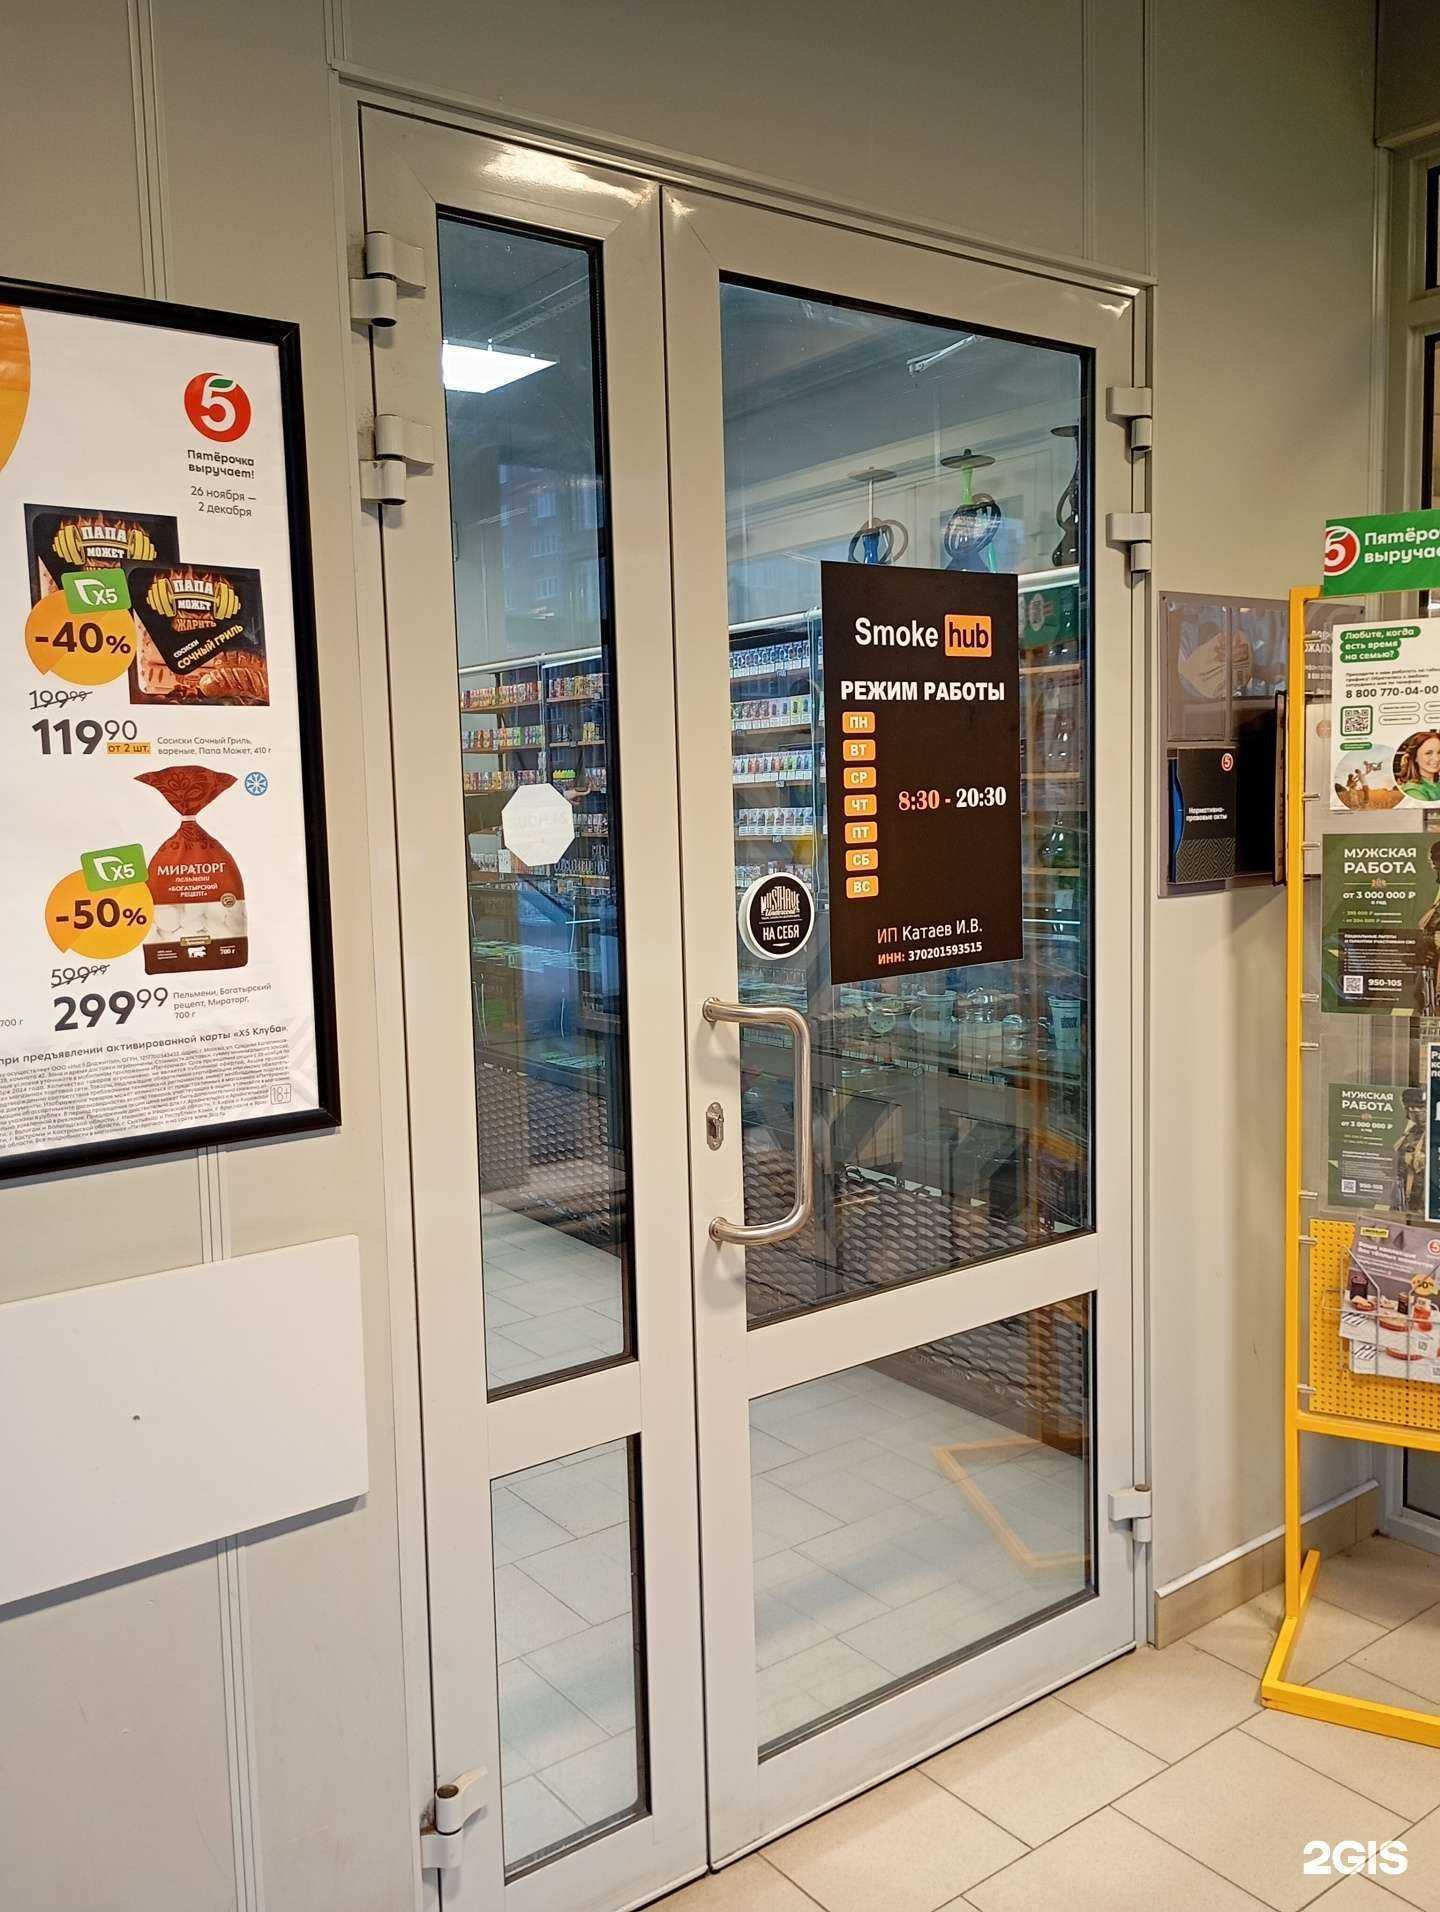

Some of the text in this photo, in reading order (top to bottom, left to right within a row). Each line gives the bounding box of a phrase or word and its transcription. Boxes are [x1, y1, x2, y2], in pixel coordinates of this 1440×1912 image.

[187, 449, 255, 467] Пятёрочка
[188, 463, 255, 479] выручает!
[190, 485, 204, 497] 26
[206, 489, 245, 502] ноября
[198, 501, 252, 518] 2 декабря
[80, 526, 127, 543] ПАПА
[1364, 527, 1440, 546] Пятёро
[86, 547, 125, 559] МОЖЕТ
[172, 579, 214, 595] ПАПА
[177, 599, 212, 611] МОЖЕТ
[35, 621, 131, 654] -40%
[854, 616, 990, 649] Smoke hub
[1345, 627, 1415, 640] Любите, когда
[177, 624, 244, 669] СОЧНЫЙ ГРИЛЬ
[1368, 641, 1398, 650] время
[1359, 650, 1395, 660] семью?
[840, 680, 1005, 701] РЕЖИМ РАБОТЫ
[1345, 685, 1439, 698] 8 800 770-04-00
[849, 716, 868, 729] ПН
[157, 736, 192, 745] Сосиски
[194, 736, 226, 745] Сочный
[108, 743, 150, 753] от 2 шт.
[199, 747, 221, 756] Папа
[222, 747, 253, 756] Может,
[850, 744, 867, 757] ВТ
[850, 772, 868, 784] СР
[851, 799, 869, 811] ЧТ
[898, 789, 940, 811] 8:30
[955, 786, 1007, 808] 20:30
[852, 826, 870, 838] ПТ
[1344, 847, 1417, 858] МУЖСКАЯ
[852, 853, 870, 866] СБ
[157, 862, 227, 876] МИРАТОРГ
[1344, 861, 1417, 874] РАБОТА
[853, 880, 871, 893] ВС
[1356, 891, 1362, 899] 3
[1364, 891, 1384, 899] 000
[1386, 891, 1406, 899] 000
[56, 897, 147, 930] -50%
[762, 924, 800, 941] НА СЕБЯ
[877, 918, 983, 944] ИП Катаев И.В.
[878, 941, 983, 965] ИНН: 370201593515
[1368, 978, 1402, 987] 950-105
[173, 983, 272, 1000] Пельмени, Богатырский
[173, 995, 250, 1011] рецепт, Мираторг,
[175, 1011, 190, 1020] 700
[0, 1019, 17, 1027] 700
[23, 1046, 103, 1063] предъявлении
[106, 1034, 197, 1053] активированной
[200, 1032, 231, 1043] карты
[1341, 1090, 1394, 1101] МУЖСКАЯ
[1341, 1100, 1394, 1112] РАБОТА
